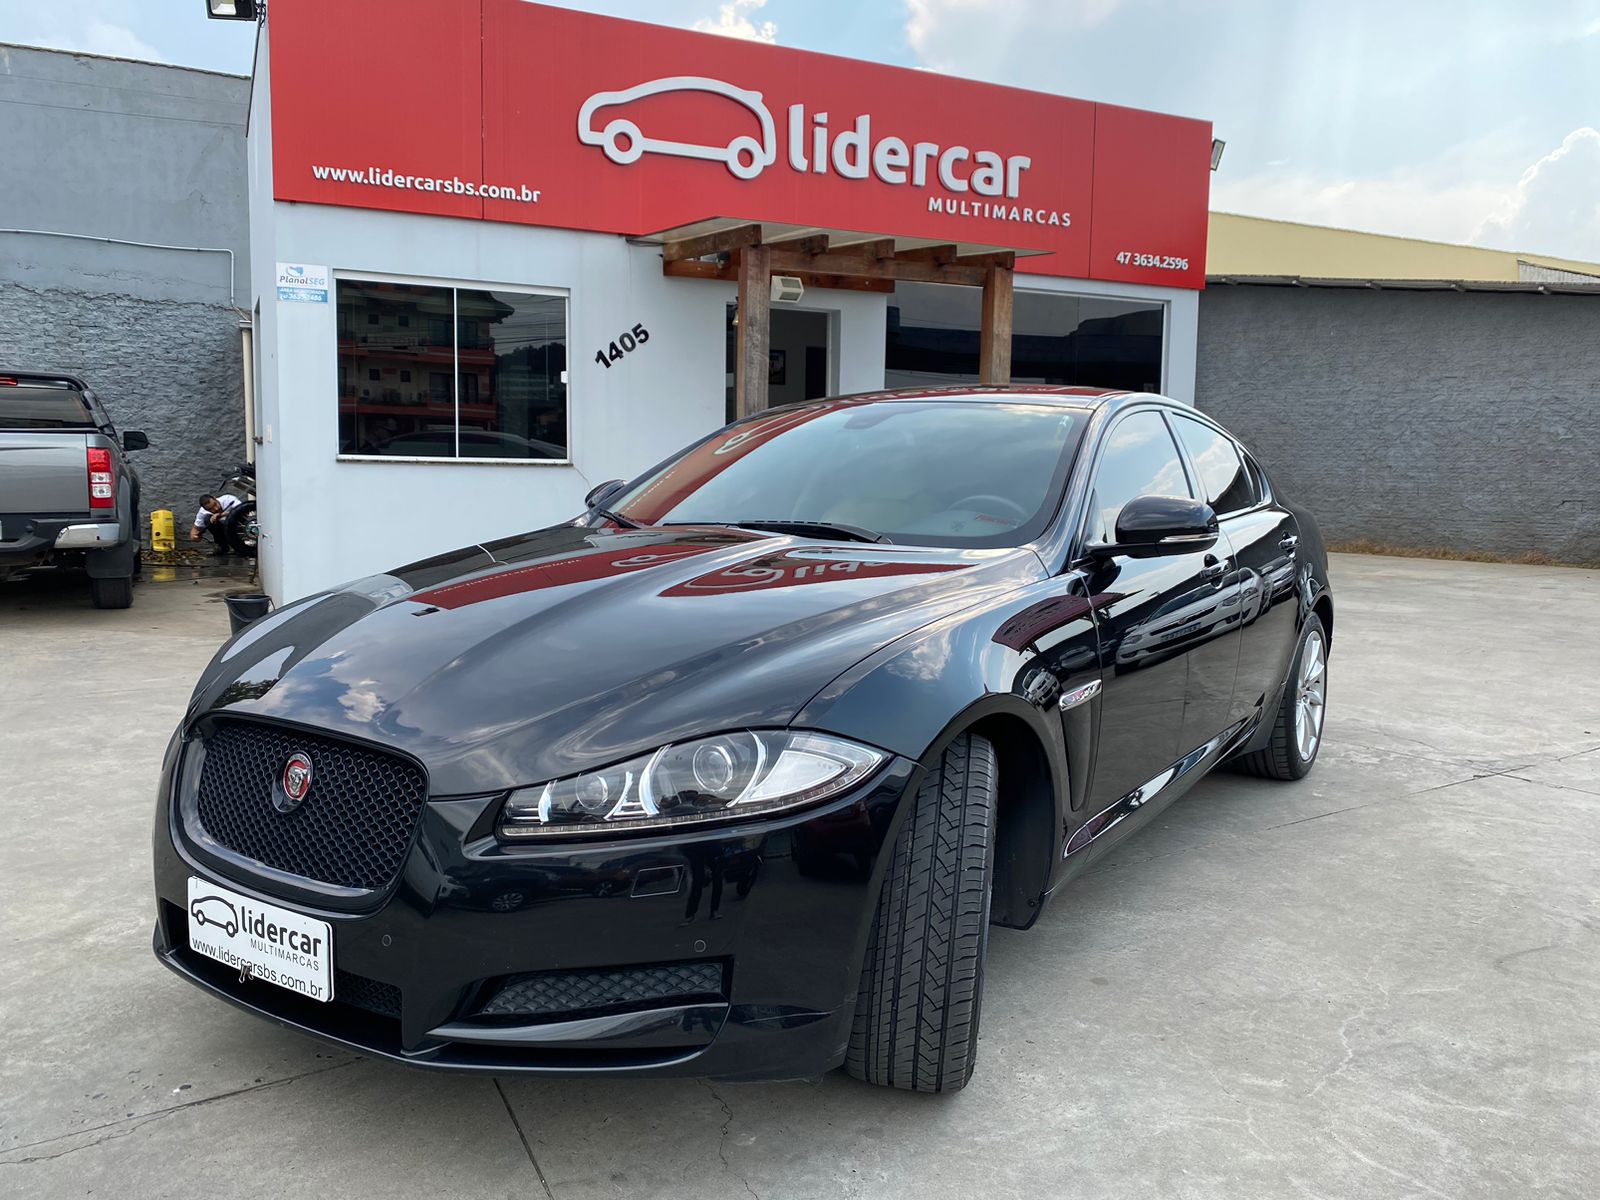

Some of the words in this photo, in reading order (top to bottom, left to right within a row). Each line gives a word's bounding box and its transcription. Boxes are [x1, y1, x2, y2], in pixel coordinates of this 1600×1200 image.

[788, 104, 1031, 198] lidercar
[312, 165, 541, 202] www.lidercarsbs.com.br
[928, 197, 1072, 227] MULTIMARCAS
[1116, 251, 1131, 264] 47
[1133, 253, 1189, 270] 3634.2596
[595, 323, 650, 369] 1405
[241, 906, 321, 957] lidercar
[250, 938, 319, 971] MULTIMARCAS
